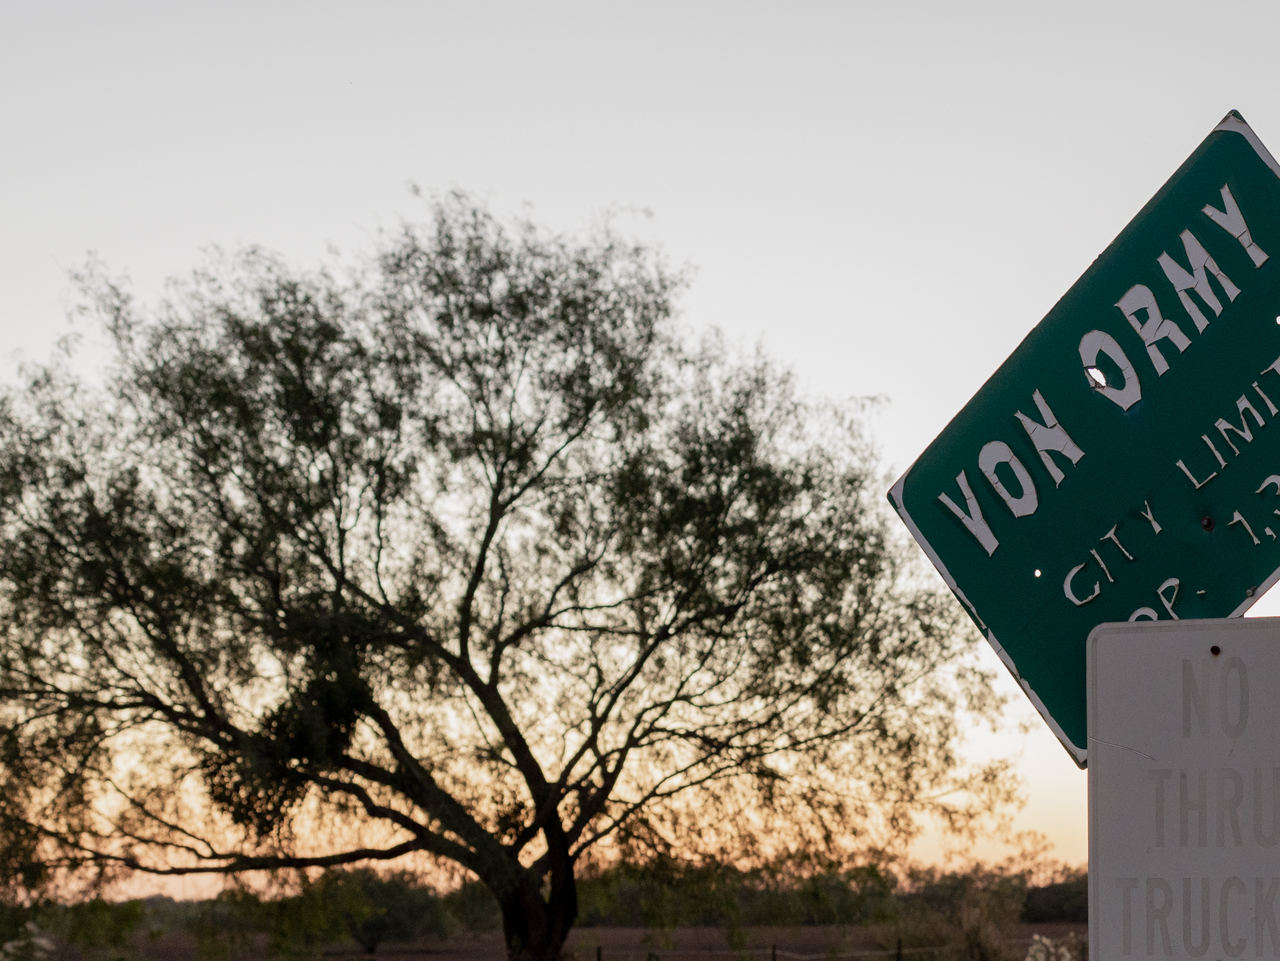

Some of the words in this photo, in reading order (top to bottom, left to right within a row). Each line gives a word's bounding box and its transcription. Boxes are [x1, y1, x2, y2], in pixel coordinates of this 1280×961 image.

[937, 388, 1086, 558] VON
[1078, 183, 1270, 412] ORMY
[1063, 500, 1163, 606] CITY
[1182, 657, 1249, 739] NO
